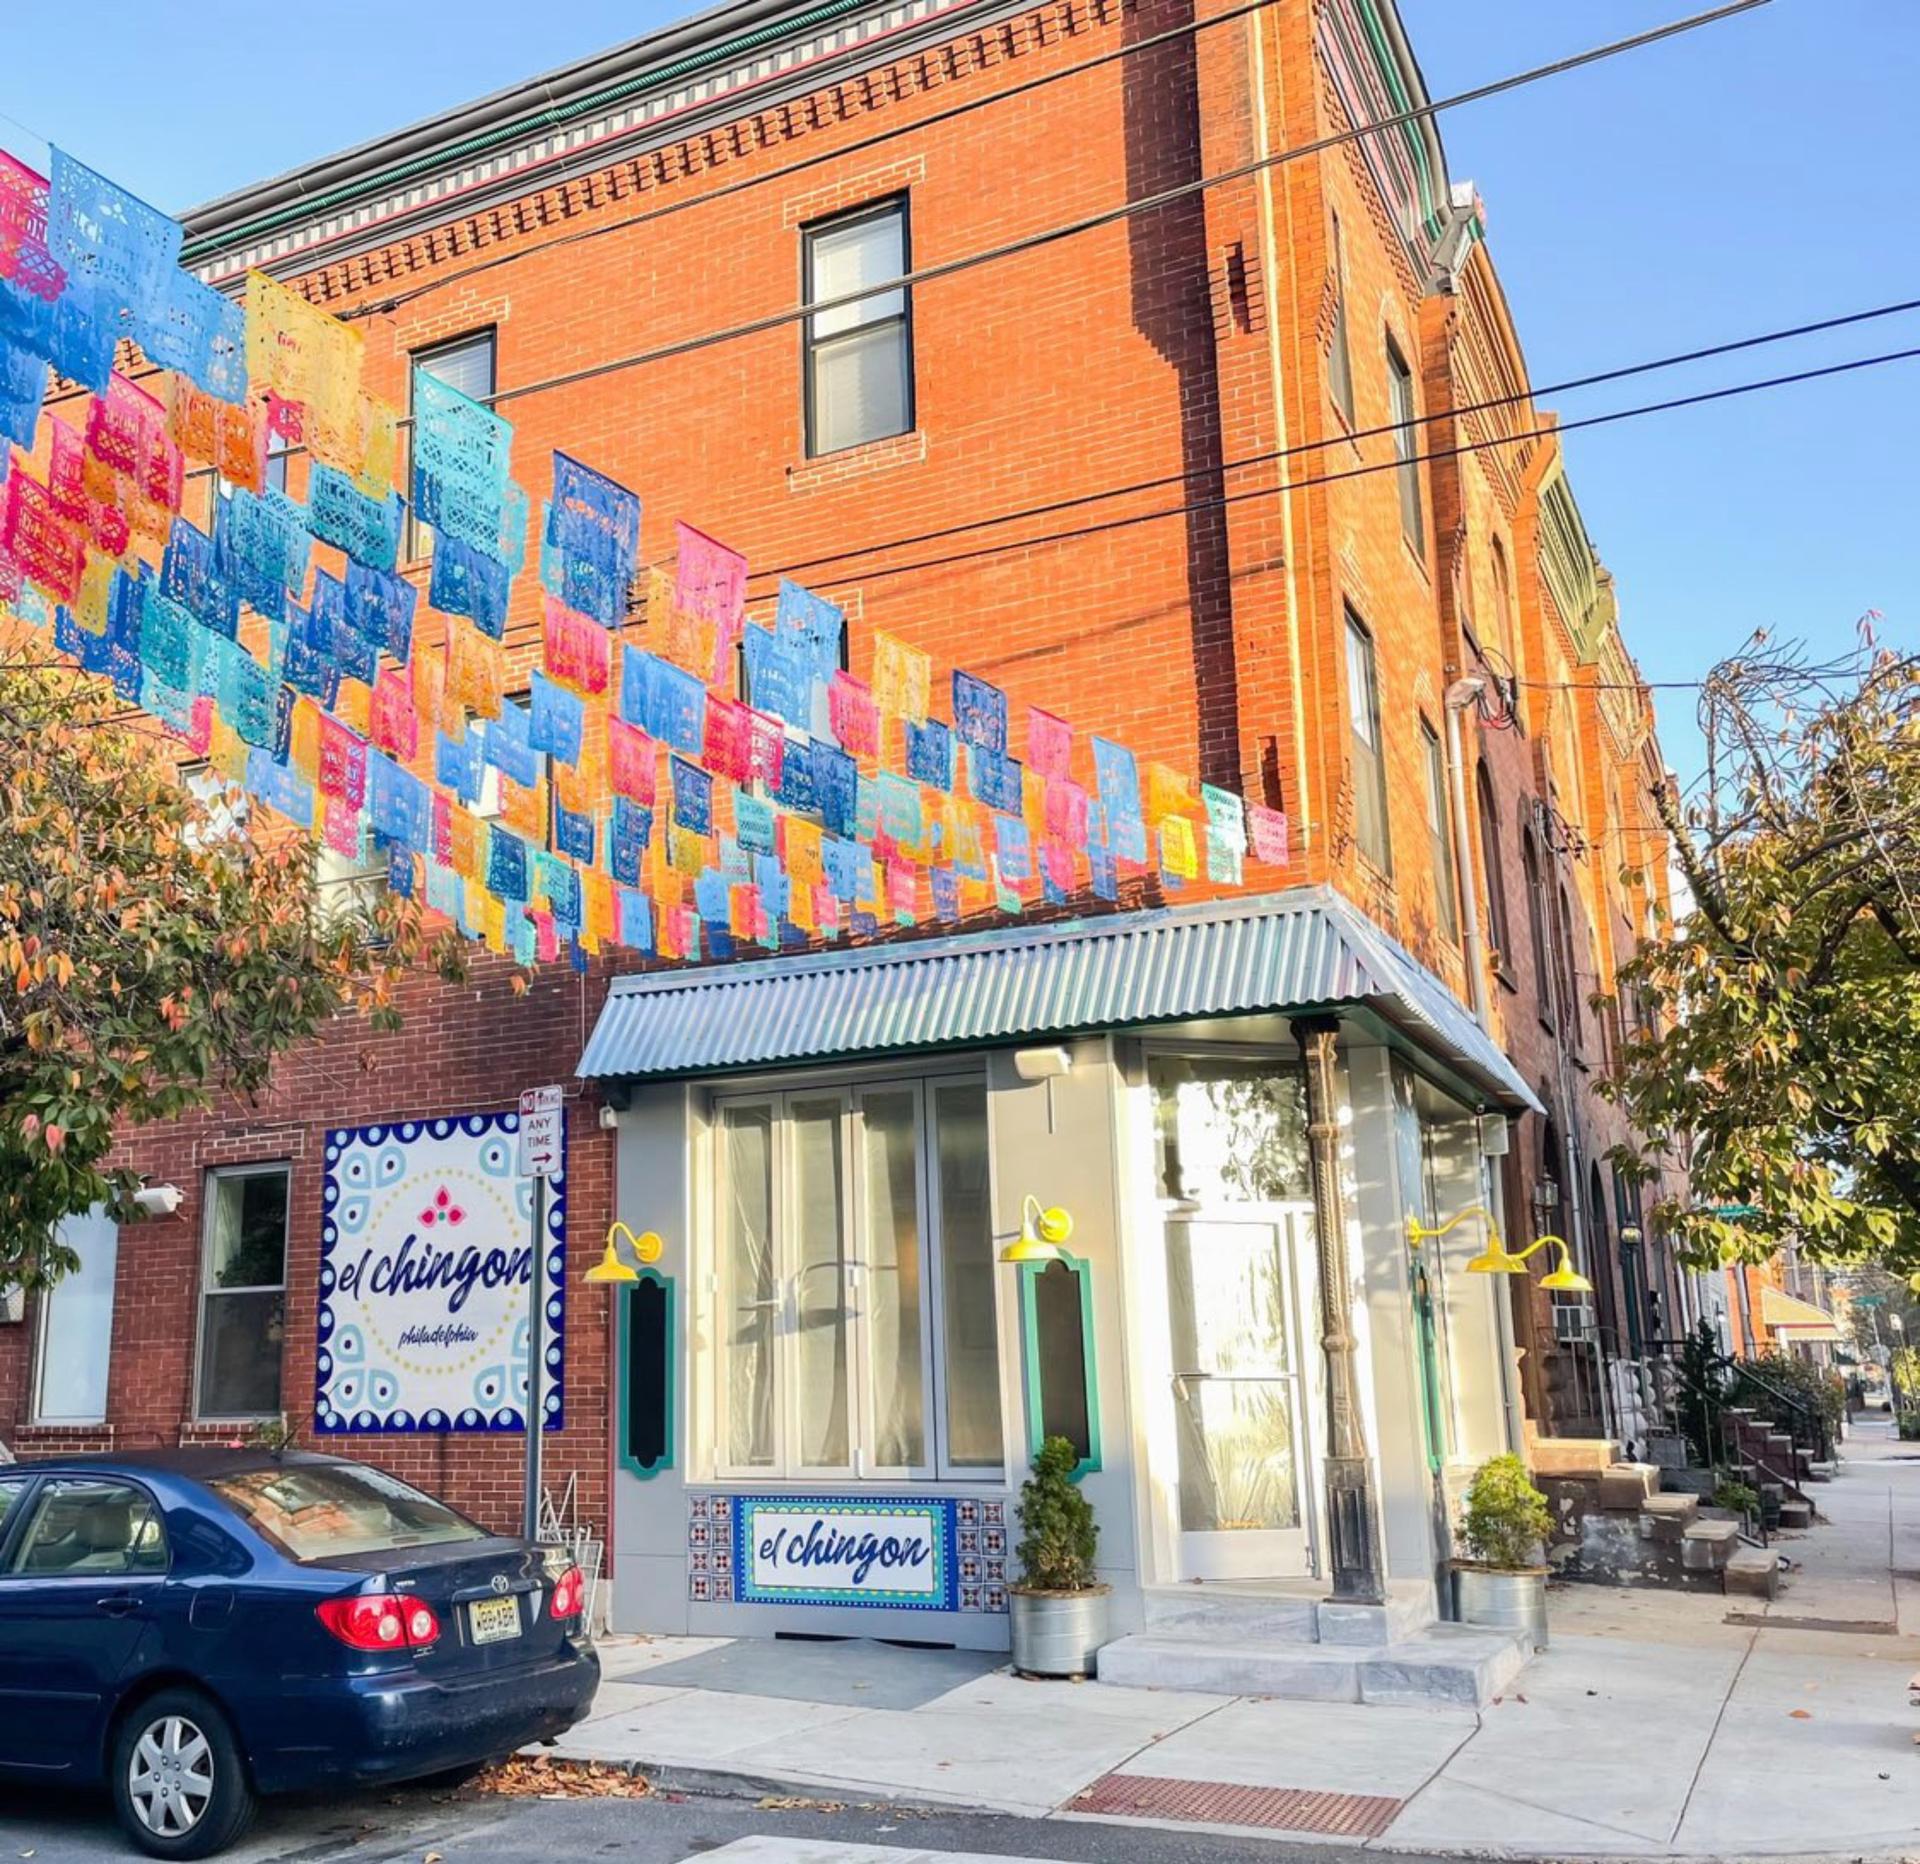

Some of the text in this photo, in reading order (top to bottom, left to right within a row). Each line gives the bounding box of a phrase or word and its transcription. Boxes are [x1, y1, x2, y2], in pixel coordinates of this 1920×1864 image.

[528, 1116, 552, 1130] ANY
[527, 1134, 552, 1148] TIME
[338, 1234, 532, 1313] el chingon
[397, 1322, 479, 1350] philadelphia
[759, 1519, 930, 1584] el chingon
